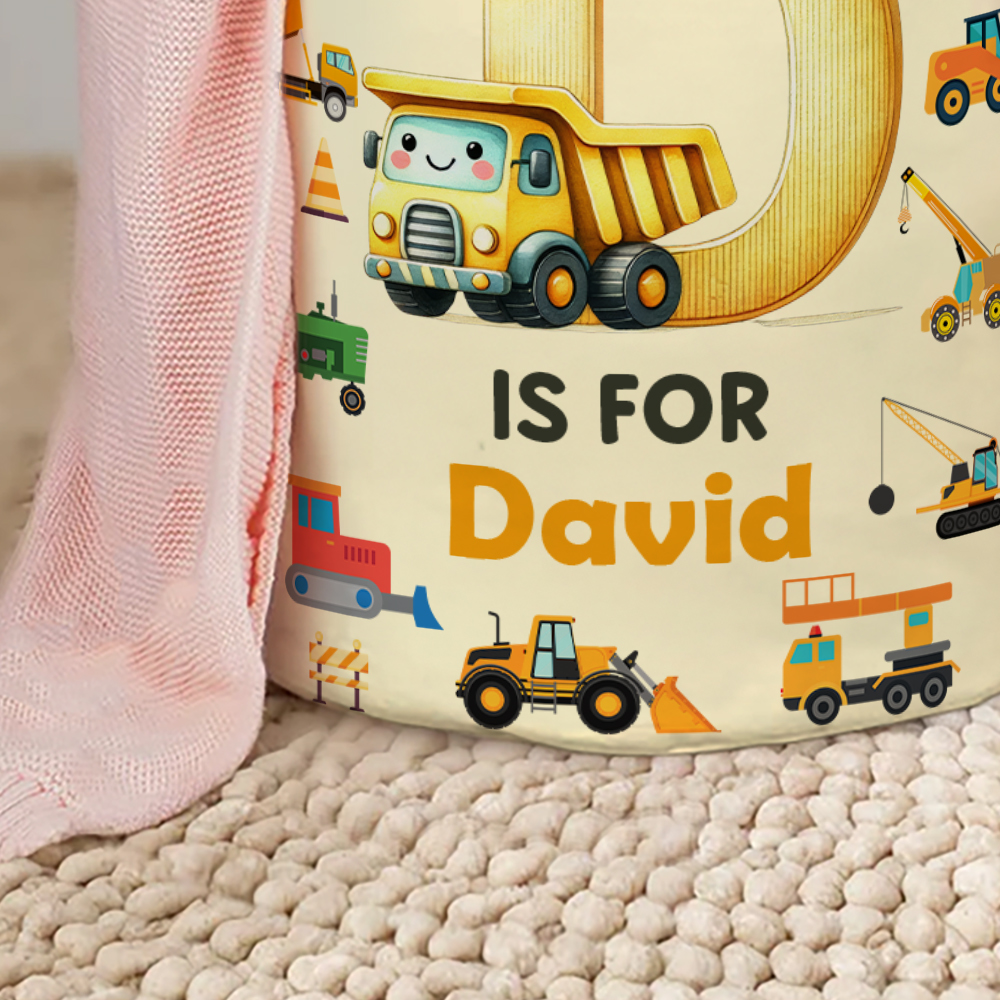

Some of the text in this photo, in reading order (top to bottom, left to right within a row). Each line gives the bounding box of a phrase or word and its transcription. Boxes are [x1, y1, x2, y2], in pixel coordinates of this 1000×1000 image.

[493, 368, 769, 445] IS FOR
[449, 462, 813, 566] David
